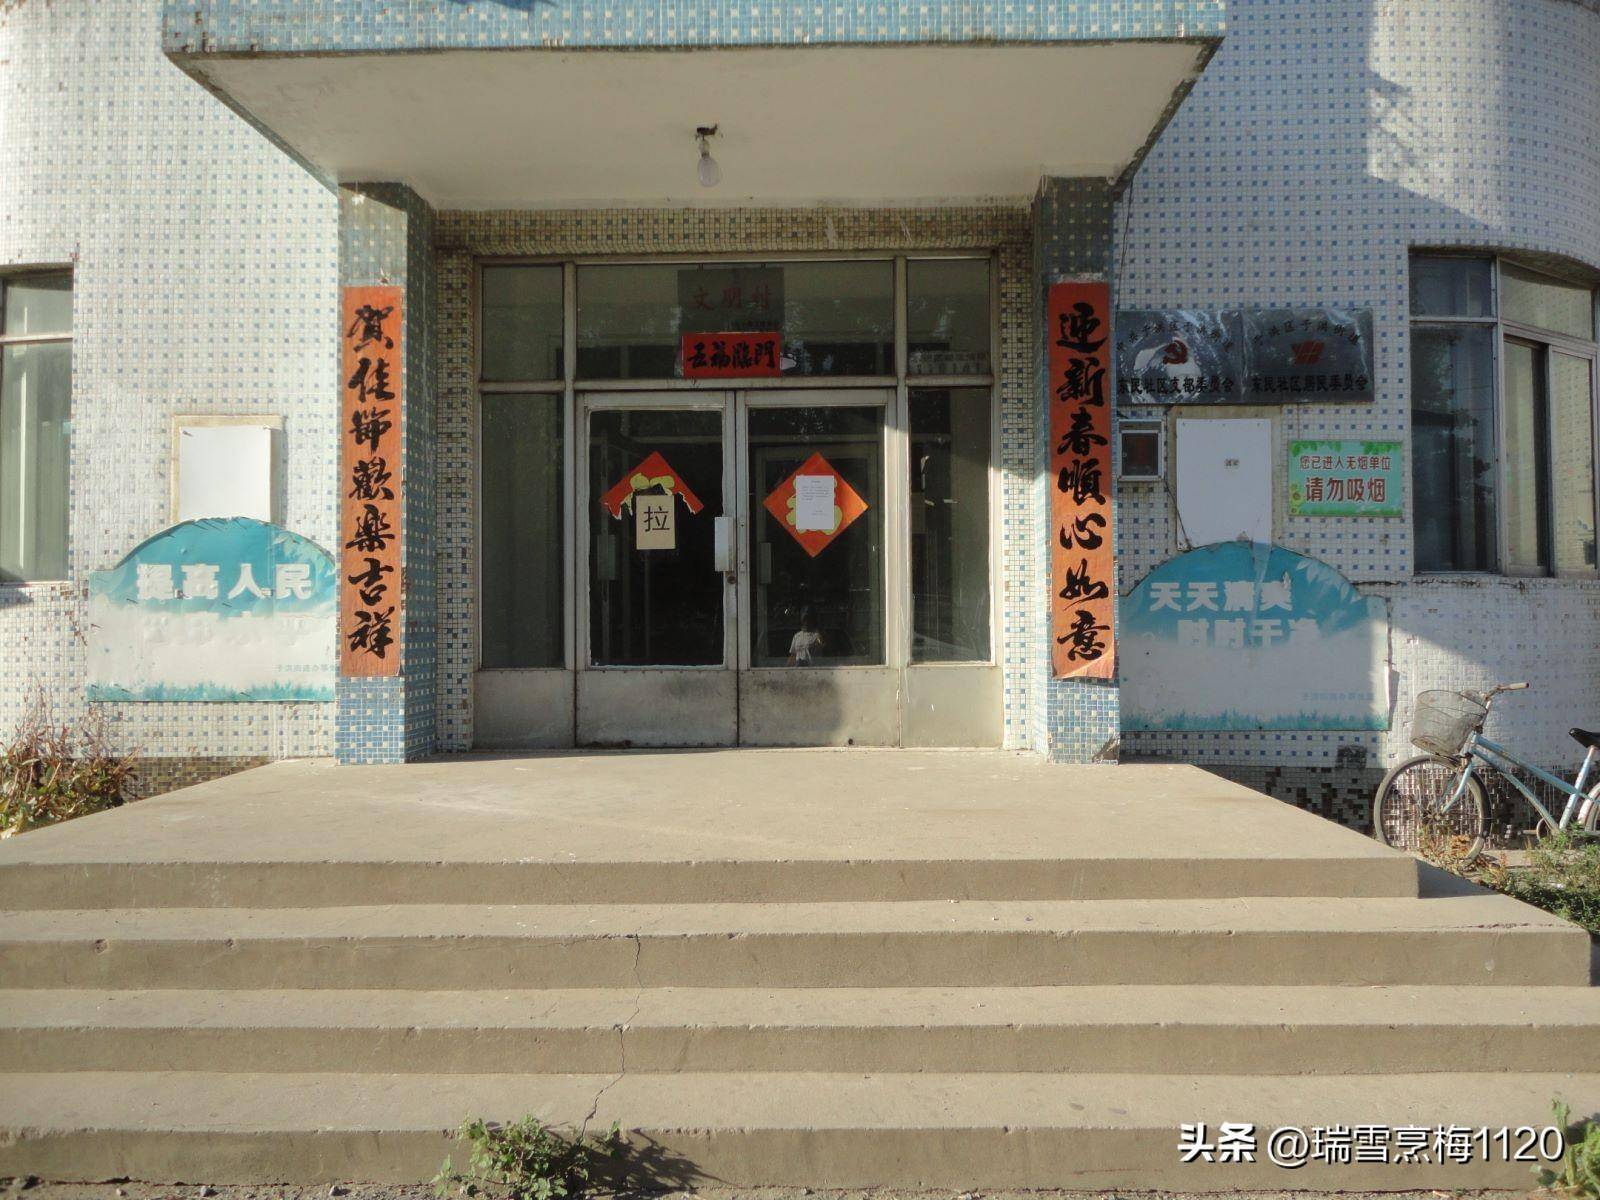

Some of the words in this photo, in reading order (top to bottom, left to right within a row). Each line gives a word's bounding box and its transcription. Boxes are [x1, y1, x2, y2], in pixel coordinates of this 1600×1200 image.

[1305, 477, 1386, 503] 请勿吸烟
[643, 505, 671, 533] 拉
